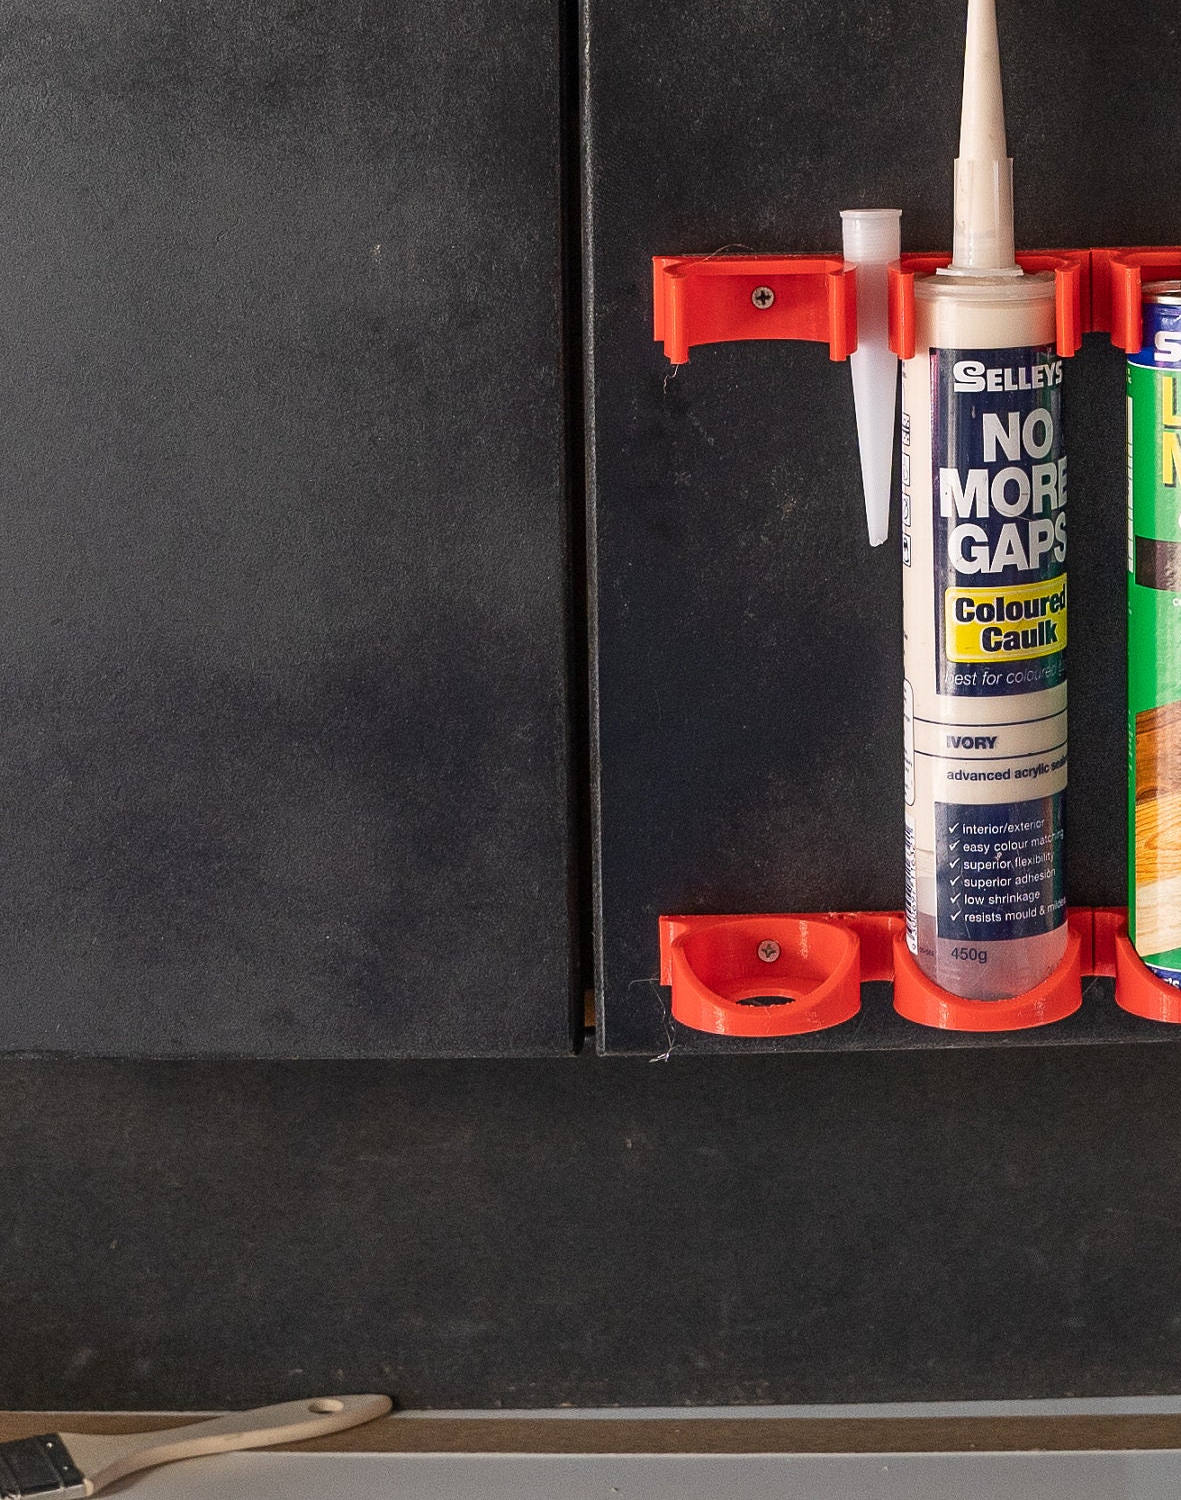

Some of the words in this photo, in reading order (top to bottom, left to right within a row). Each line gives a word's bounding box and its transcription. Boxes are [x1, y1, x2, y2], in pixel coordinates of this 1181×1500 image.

[953, 360, 1062, 393] SELLEYS
[982, 407, 1053, 463] NO
[939, 455, 1067, 519] MORE
[947, 511, 1067, 575] GAPS
[955, 583, 1066, 623] Coloured
[981, 619, 1058, 652] Caulk
[982, 671, 1002, 686] for
[946, 736, 998, 750] IVORY
[947, 769, 1011, 781] advanced
[1014, 761, 1050, 779] acrylic
[962, 819, 1045, 835] interior/exterior
[963, 844, 990, 855] easy
[994, 839, 1028, 852] colour
[963, 858, 1011, 872] superior
[1015, 851, 1054, 867] flexibility
[964, 876, 1012, 890] superior
[1015, 868, 1056, 885] adhesion
[964, 893, 985, 905] low
[988, 890, 1041, 905] shrinkage
[964, 912, 1002, 923] resists
[1005, 907, 1037, 922] mould
[1039, 905, 1046, 915] &
[951, 947, 988, 964] 450g
